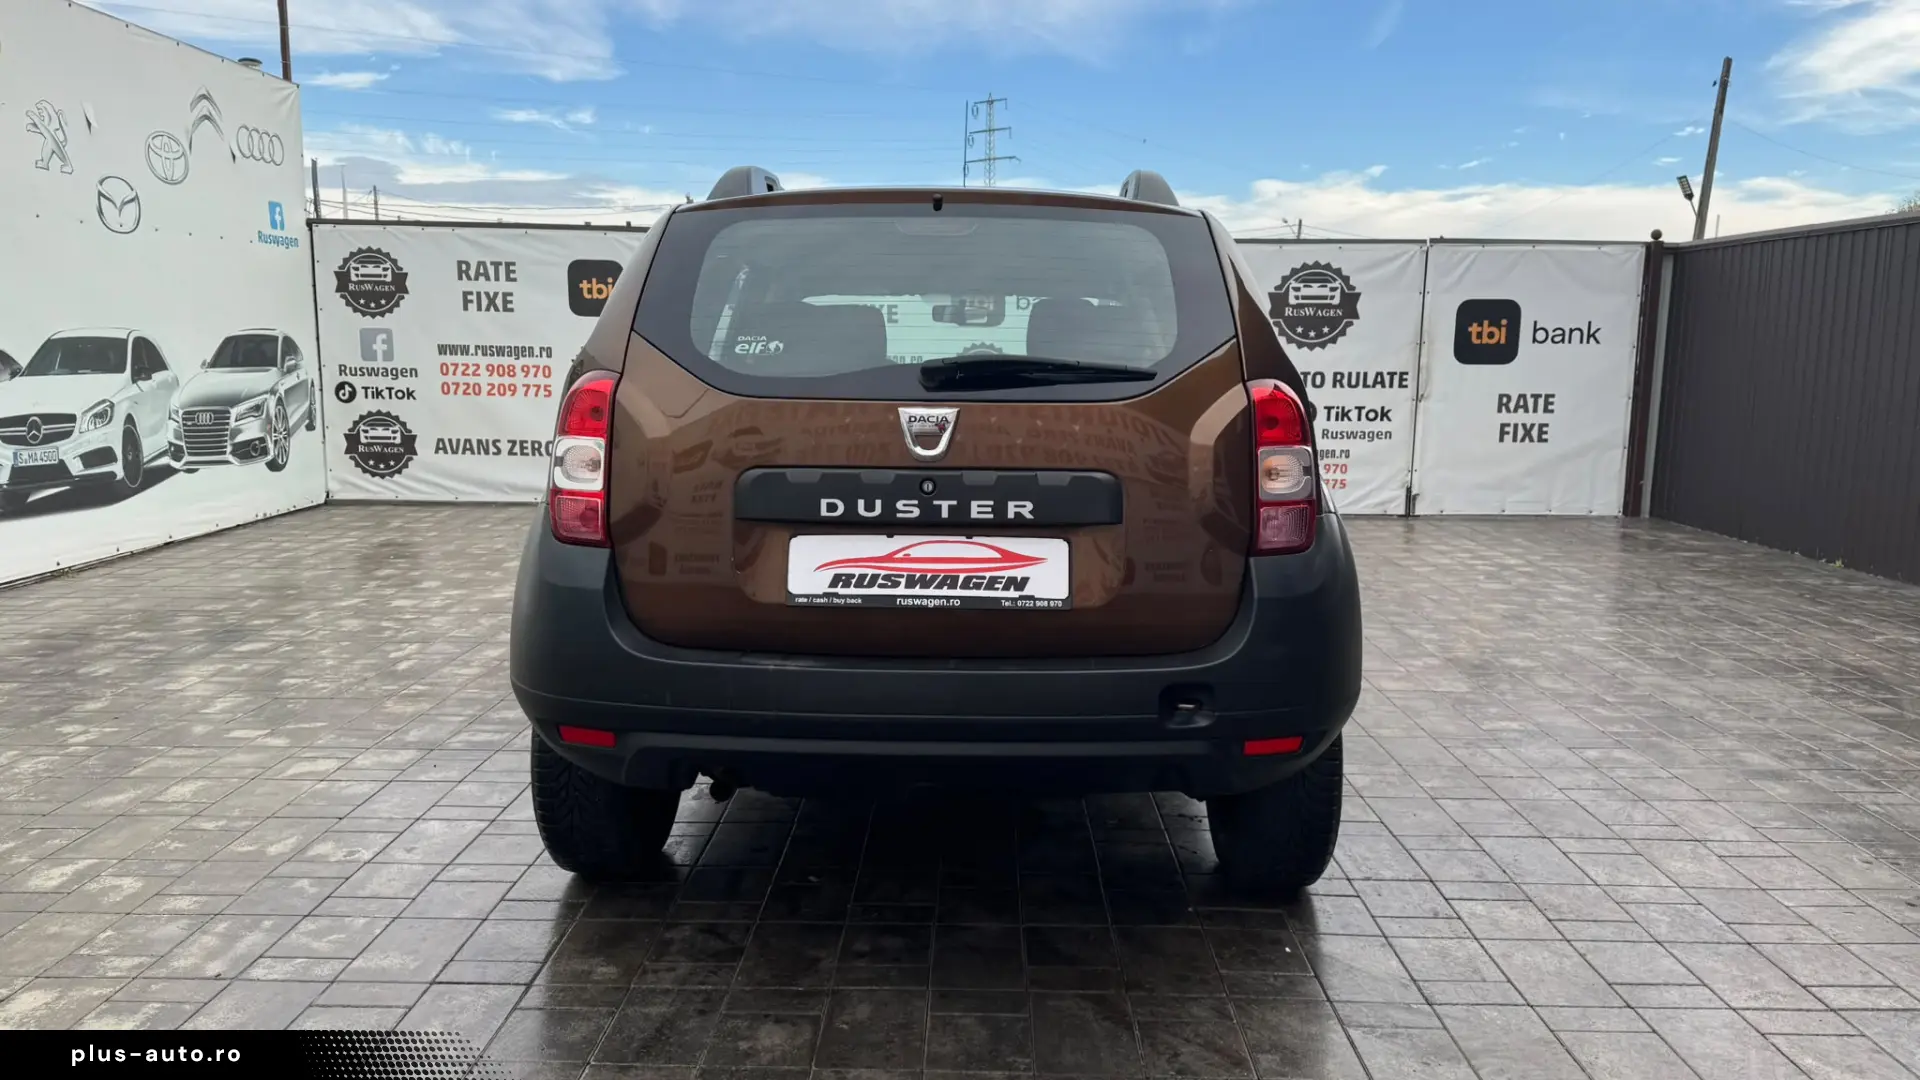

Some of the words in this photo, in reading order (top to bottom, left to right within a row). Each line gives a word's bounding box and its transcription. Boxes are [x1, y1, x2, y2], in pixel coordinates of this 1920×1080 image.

[258, 230, 299, 250] Ruswagen
[456, 260, 518, 282] RATE
[462, 291, 515, 313] FIXE
[1468, 318, 1508, 344] tbi
[1532, 320, 1602, 344] bank
[437, 344, 553, 360] www.ruswagen.ro
[735, 341, 767, 354] elf
[338, 364, 418, 380] Ruswagen
[440, 362, 481, 377] 0722
[485, 363, 517, 378] 908
[521, 364, 552, 379] 970
[1332, 371, 1409, 389] RULATE
[361, 386, 417, 400] TikTok
[441, 381, 482, 396] 0720
[486, 382, 517, 397] 209
[522, 383, 553, 398] 775
[1497, 393, 1556, 414] RATE
[908, 415, 949, 423] DACIA
[1323, 406, 1392, 422] TikTok
[1321, 428, 1392, 442] Ruswagen
[1498, 423, 1549, 443] FIXE
[434, 437, 502, 456] AVANS
[1318, 449, 1350, 460] gen.ro
[1323, 463, 1348, 474] 970
[820, 498, 1035, 519] DUSTER
[827, 573, 1031, 592] RUSWAGEN
[896, 597, 960, 607] ruswagen.ro
